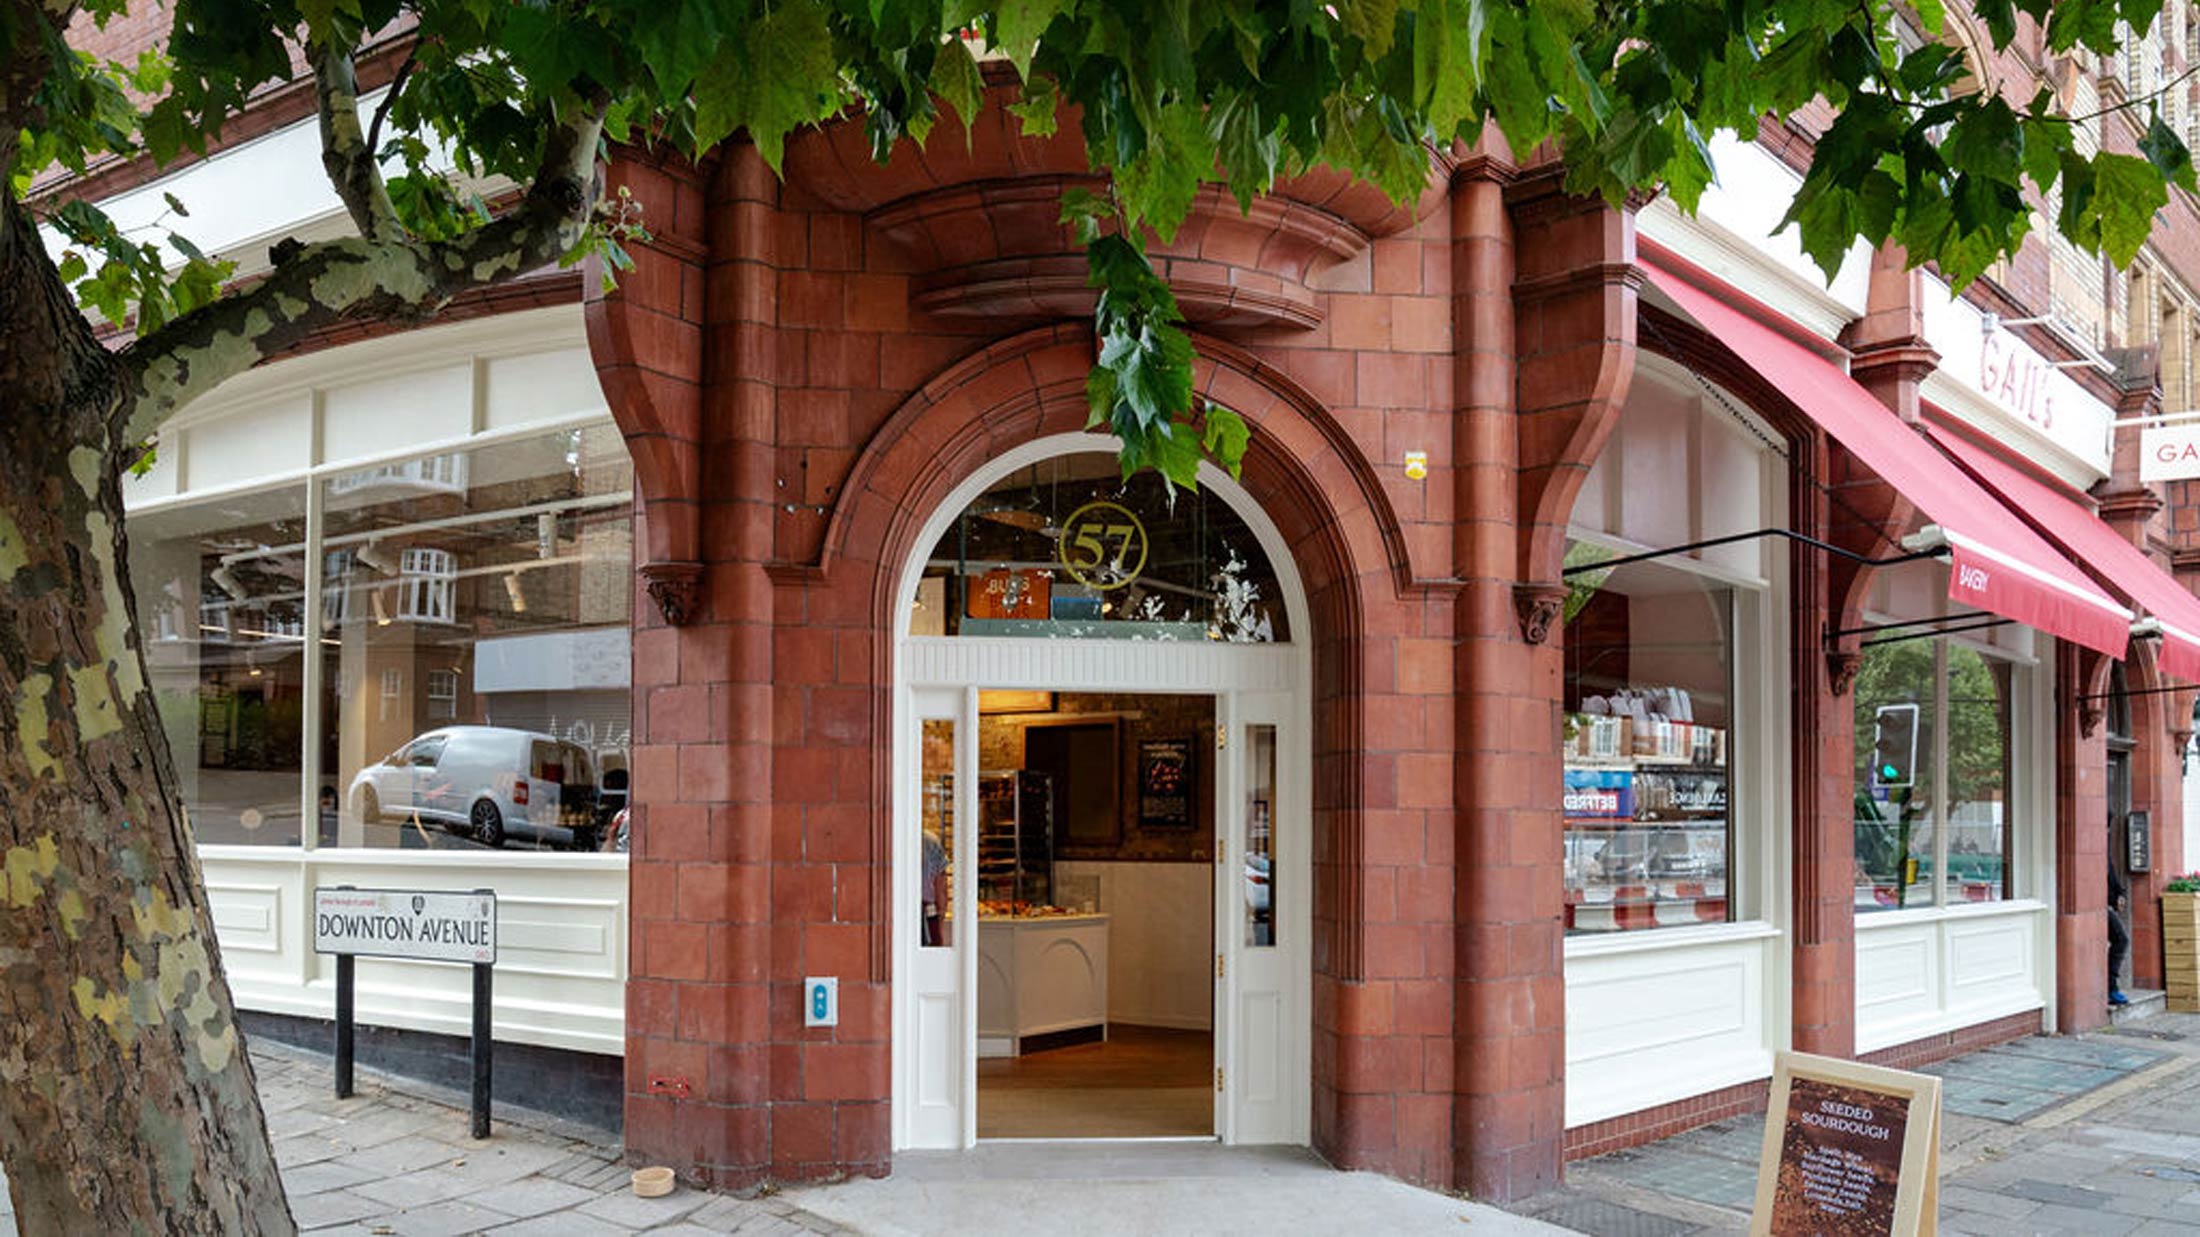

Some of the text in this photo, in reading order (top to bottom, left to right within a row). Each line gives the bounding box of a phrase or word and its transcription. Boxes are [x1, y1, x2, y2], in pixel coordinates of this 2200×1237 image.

[1074, 523, 1136, 571] 57
[1959, 564, 1990, 593] BAKERY
[319, 914, 489, 945] DOWNTON AVENUE
[1820, 1100, 1873, 1121] SEEDED
[1801, 1111, 1890, 1140] SOURDOUGH
